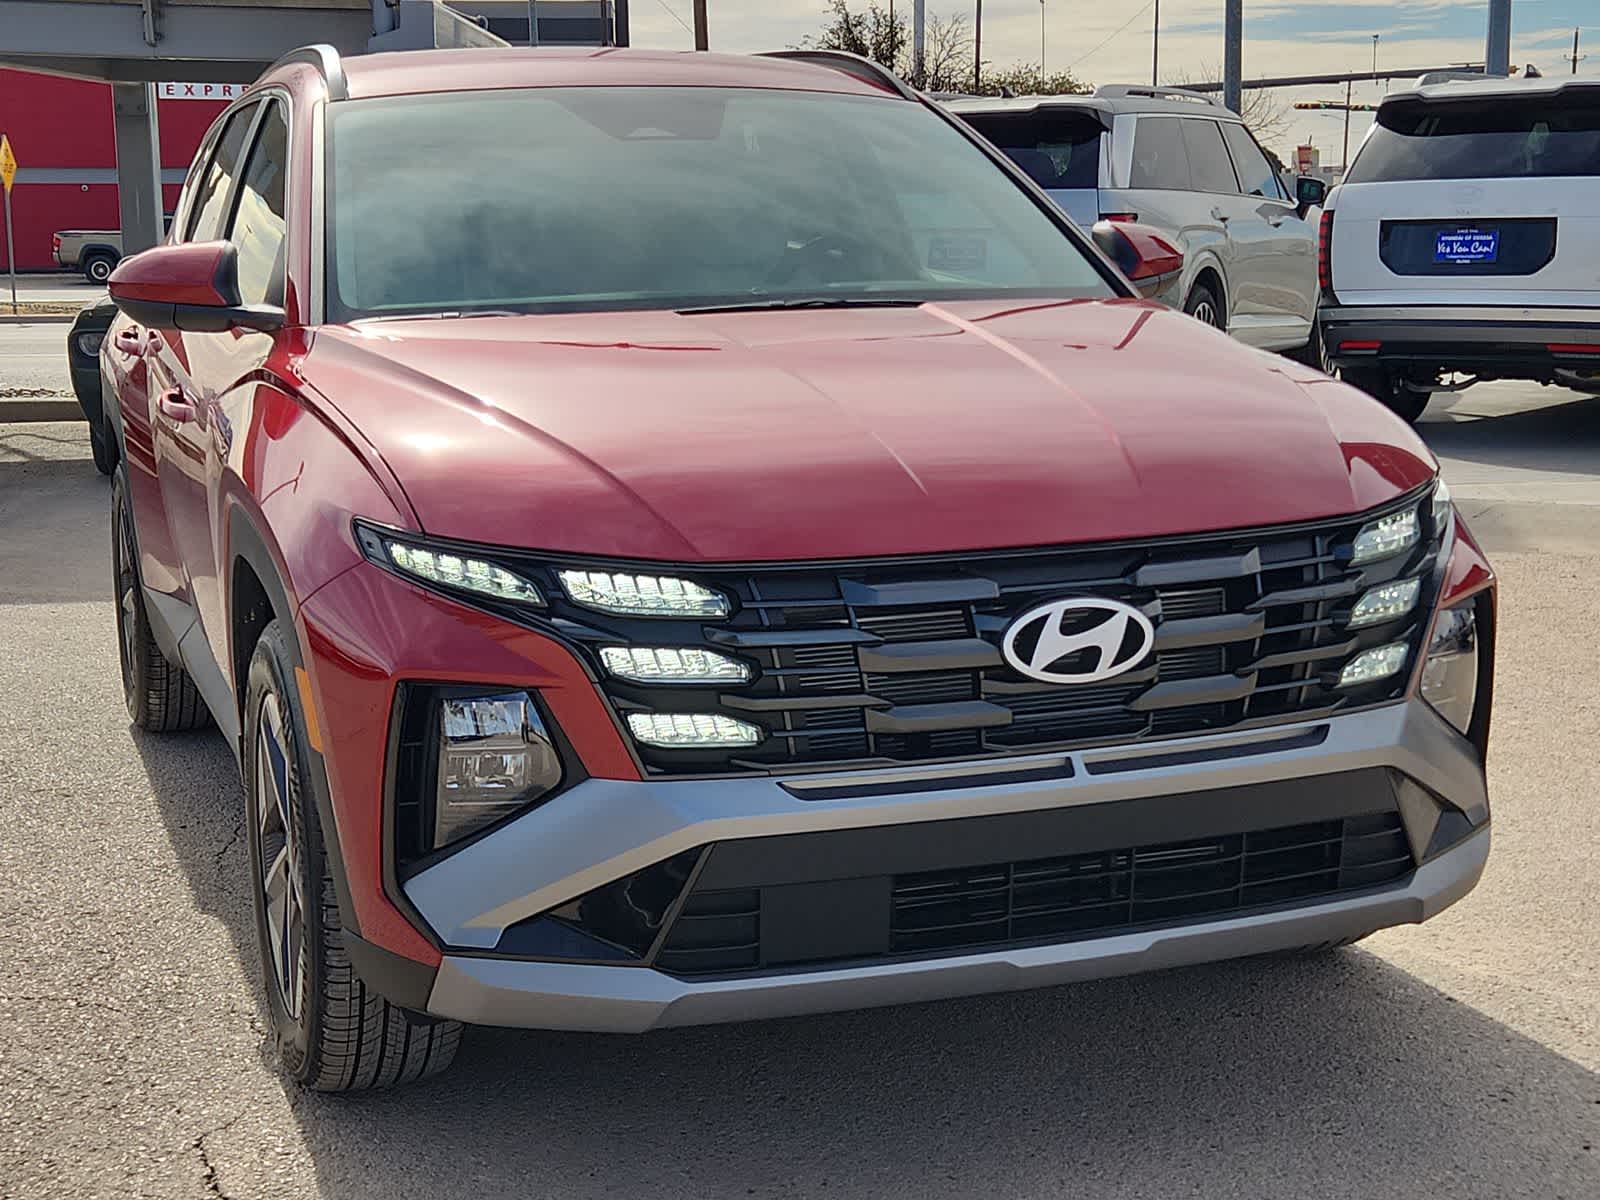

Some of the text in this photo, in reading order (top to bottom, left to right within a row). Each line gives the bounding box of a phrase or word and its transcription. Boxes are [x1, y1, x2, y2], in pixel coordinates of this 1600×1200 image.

[1437, 241, 1495, 253] Yes You Can!
